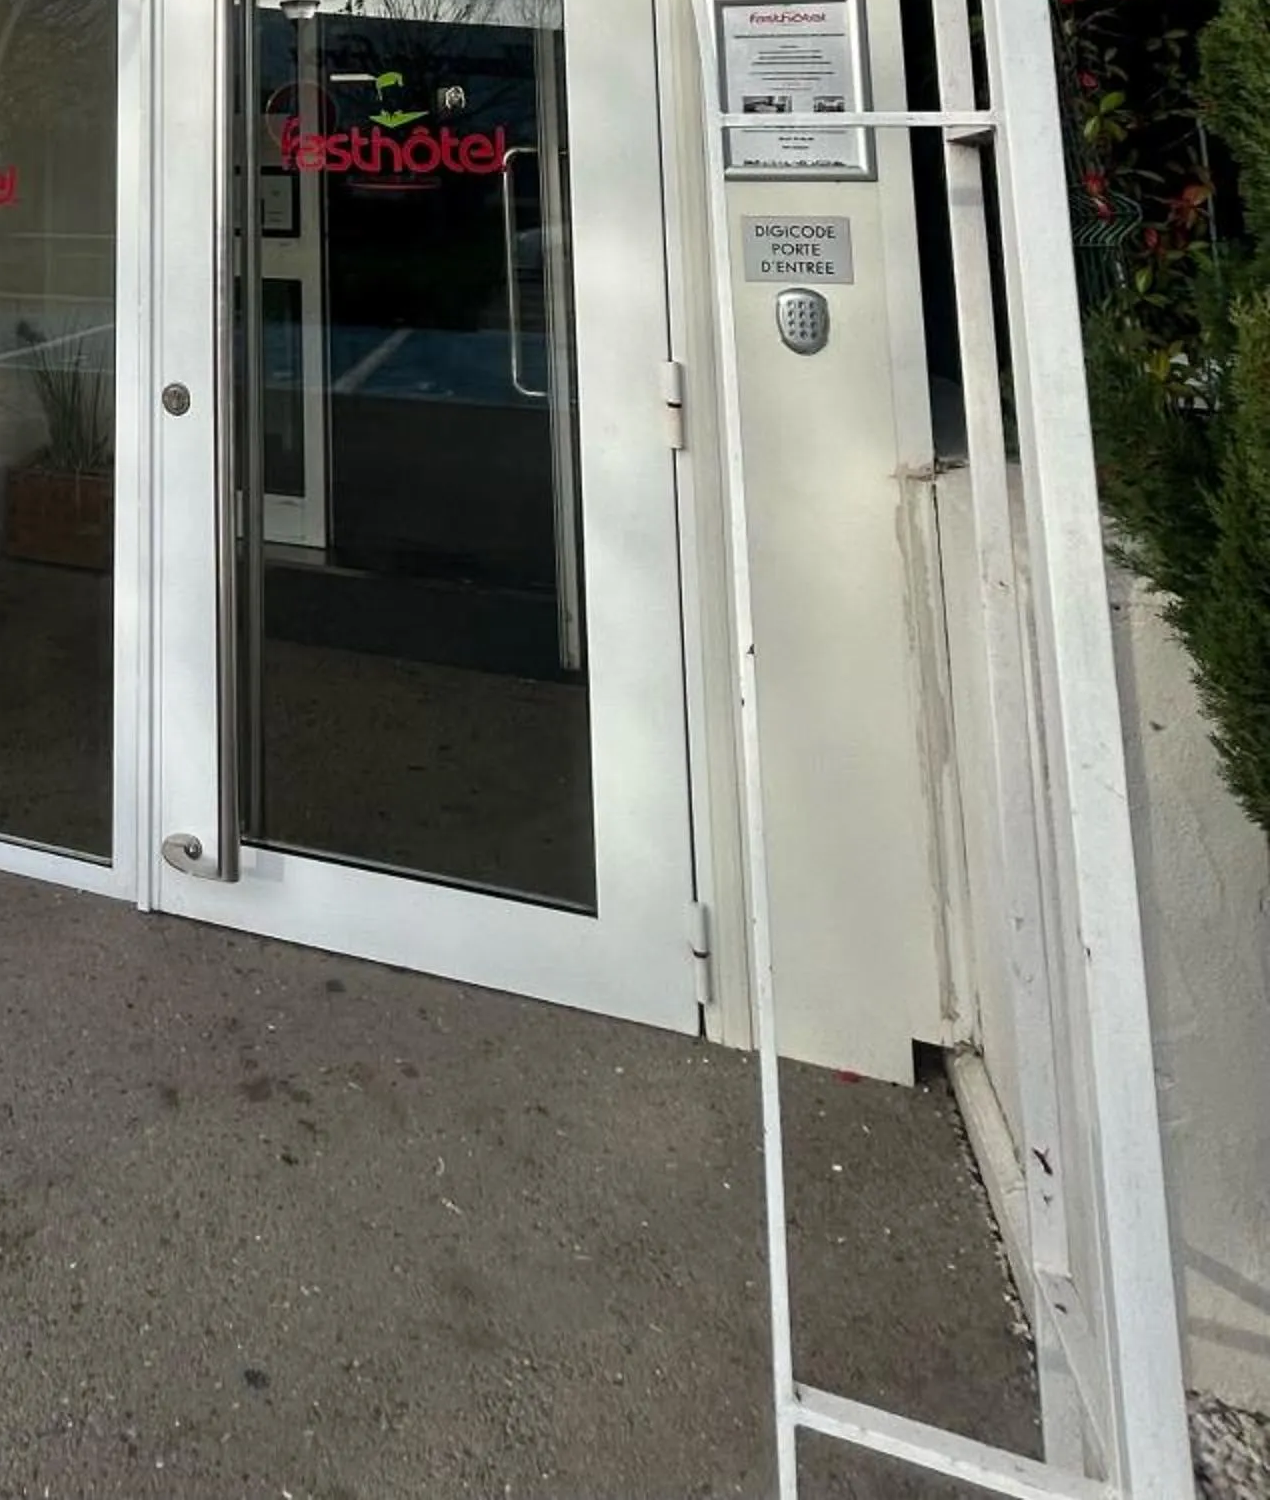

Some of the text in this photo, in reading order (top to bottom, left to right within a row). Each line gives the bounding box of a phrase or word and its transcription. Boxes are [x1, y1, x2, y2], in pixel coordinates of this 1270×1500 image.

[282, 116, 506, 174] fasthôtel
[755, 224, 836, 239] DIGICODE
[771, 243, 821, 257] PORTE
